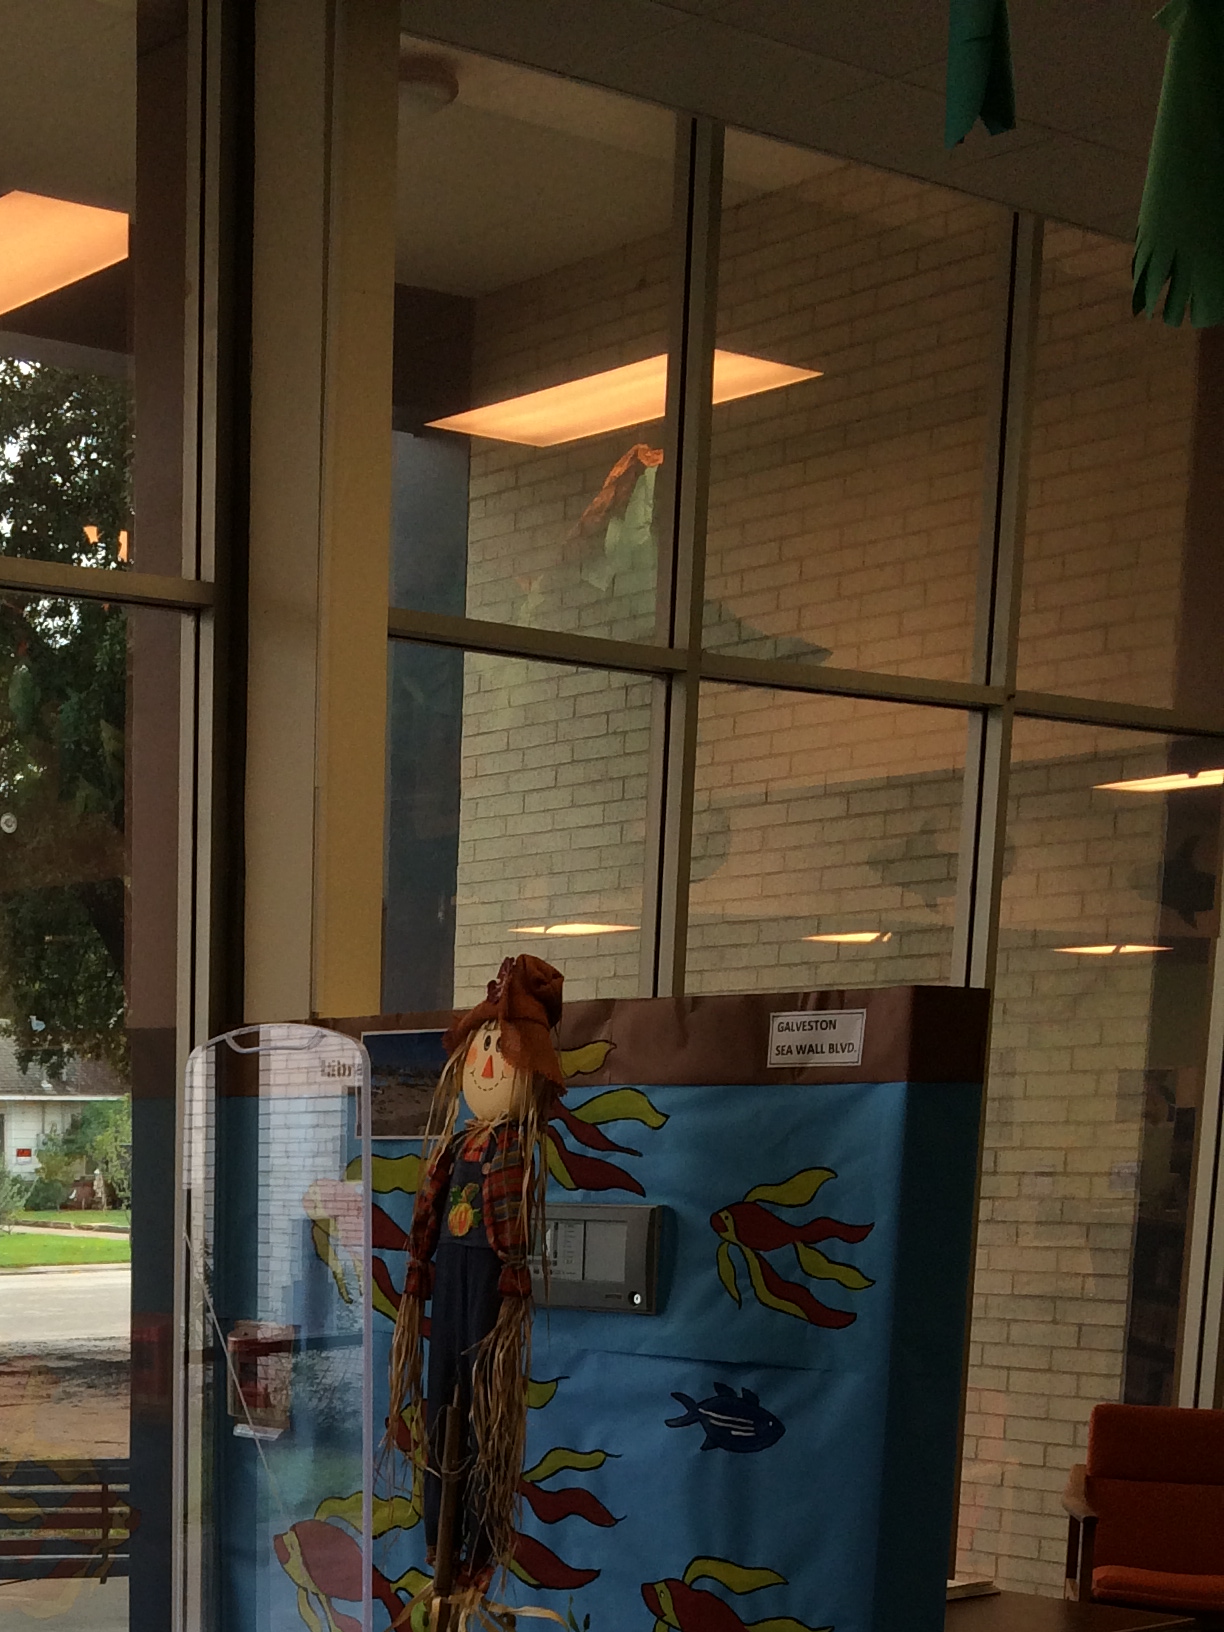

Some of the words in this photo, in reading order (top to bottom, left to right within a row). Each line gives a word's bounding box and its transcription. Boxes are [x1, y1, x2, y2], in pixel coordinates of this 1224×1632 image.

[777, 1019, 837, 1033] GALVESTON
[775, 1044, 793, 1057] SEA
[796, 1043, 826, 1055] WALL
[828, 1042, 857, 1054] BLVD.
